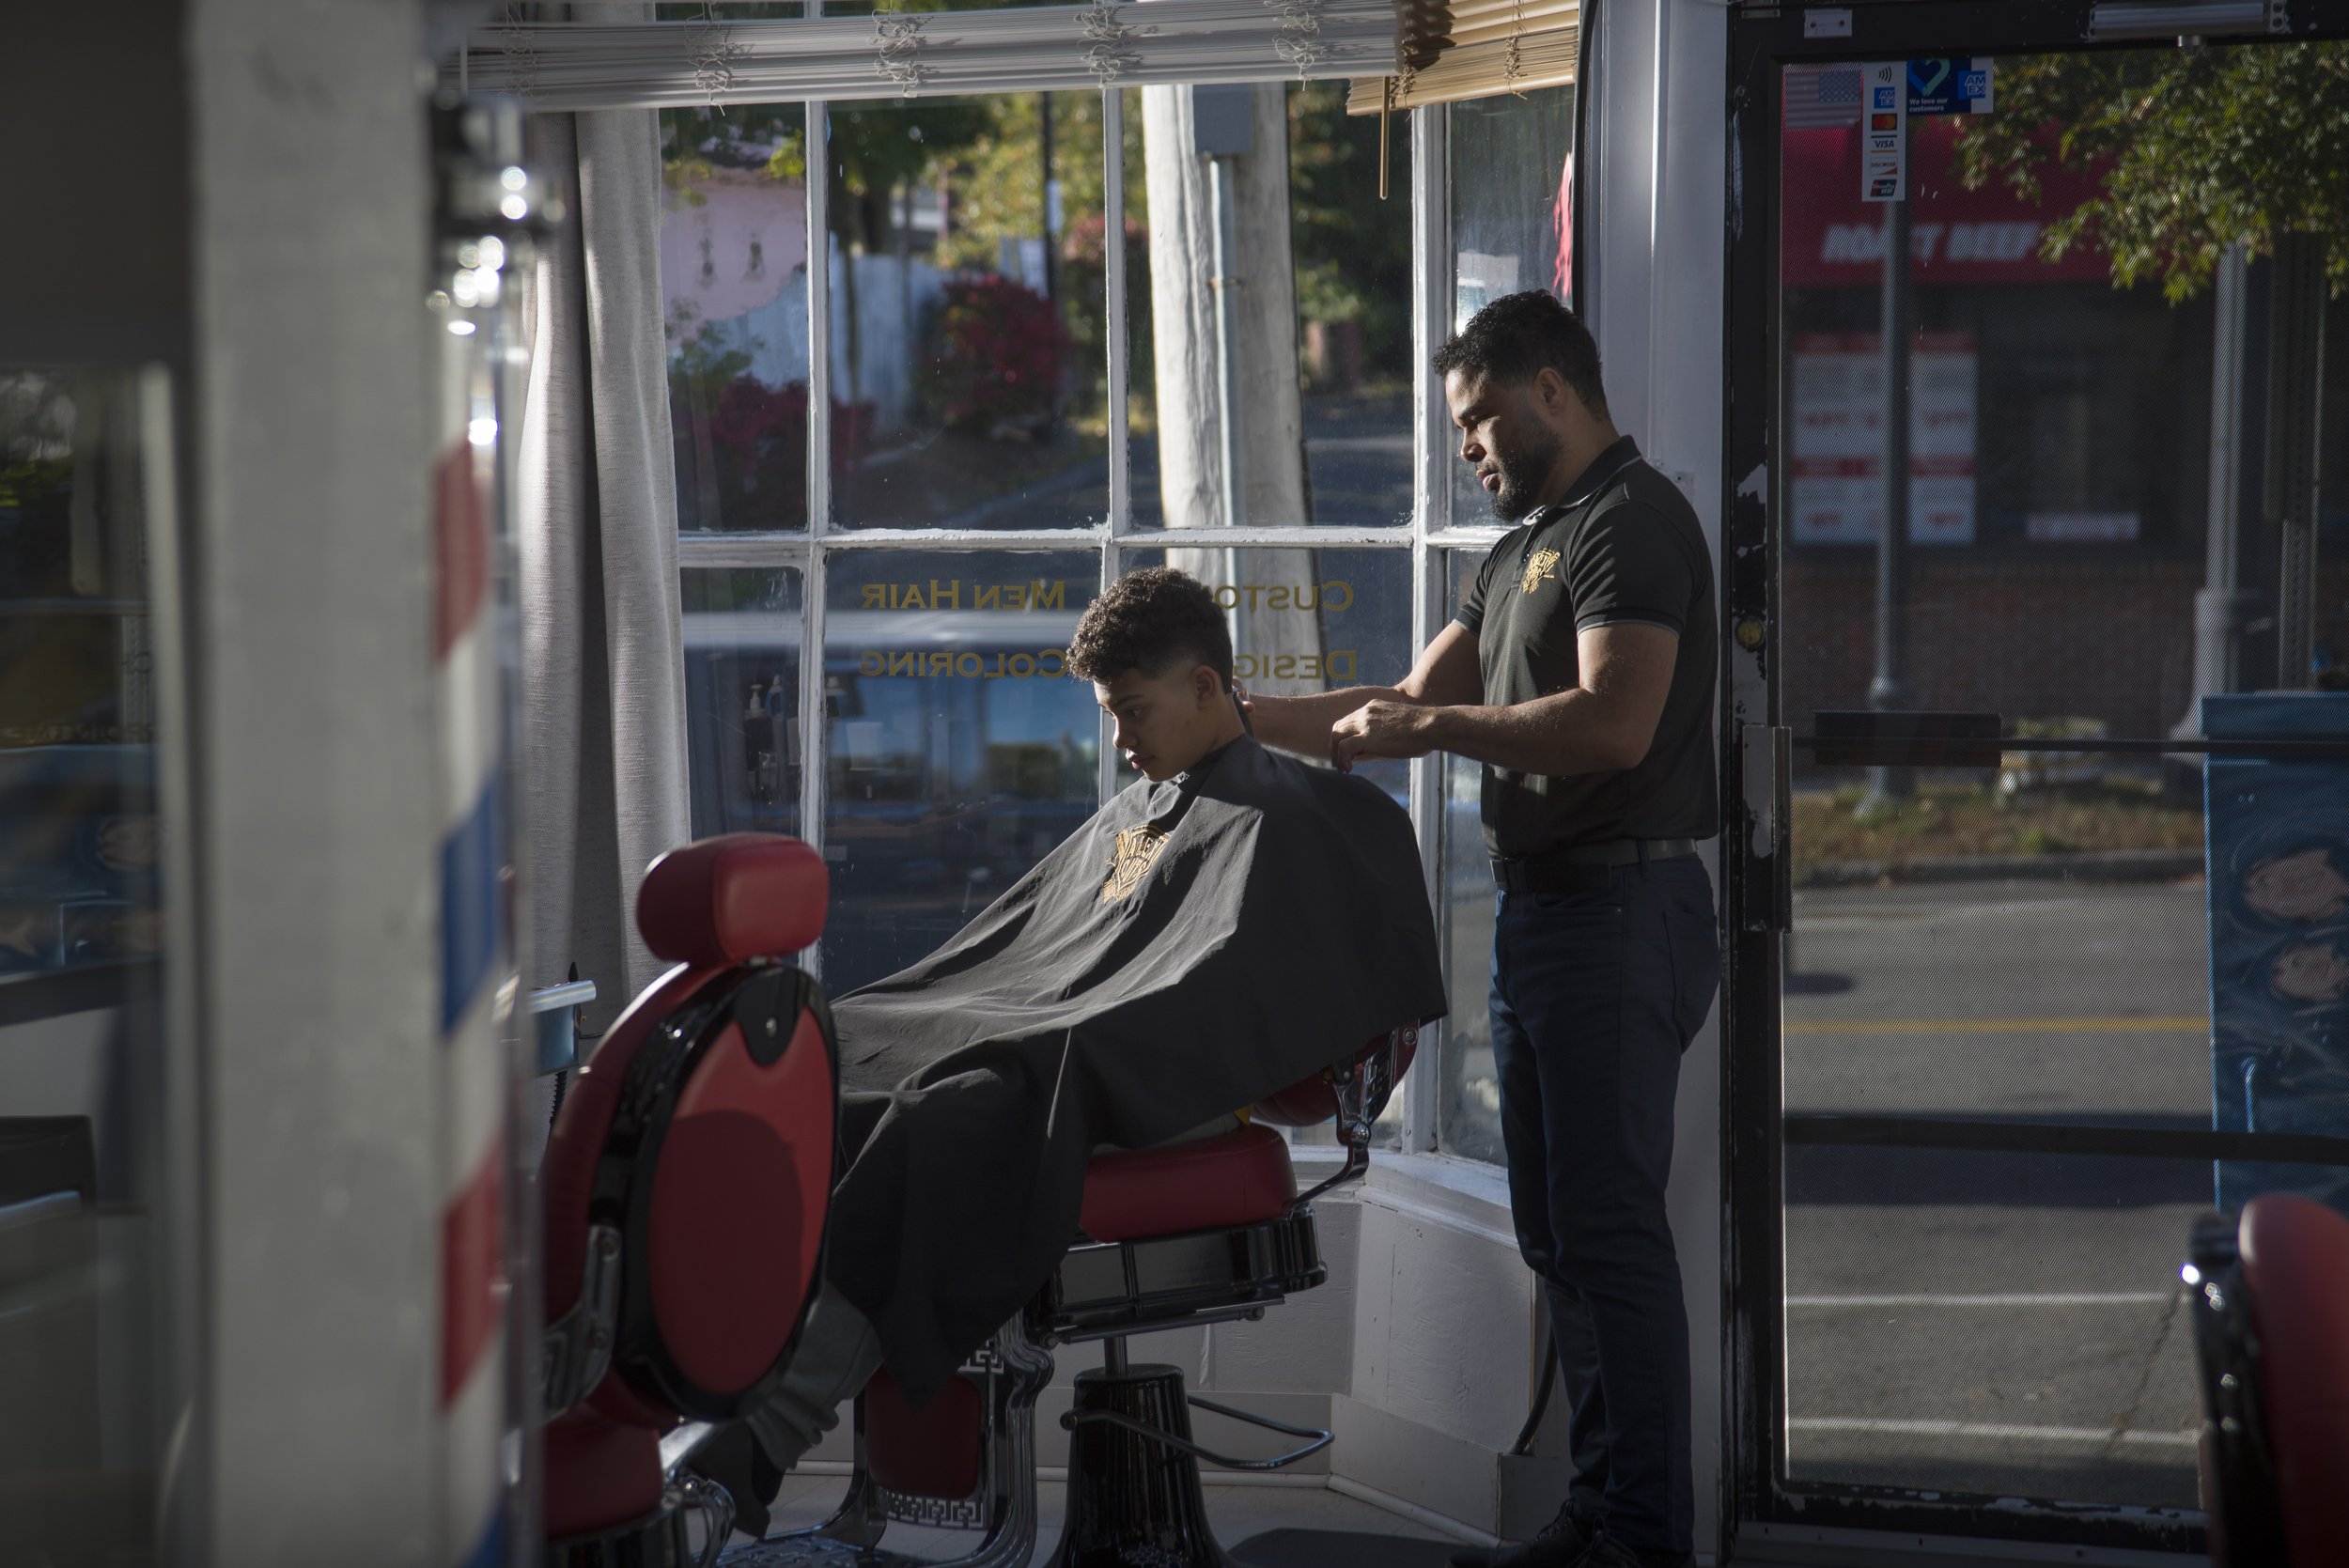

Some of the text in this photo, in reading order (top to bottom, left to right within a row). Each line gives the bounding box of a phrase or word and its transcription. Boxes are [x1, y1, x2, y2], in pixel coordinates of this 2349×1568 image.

[1875, 140, 1894, 148] VISA
[1823, 224, 2040, 262] ROT BEEF
